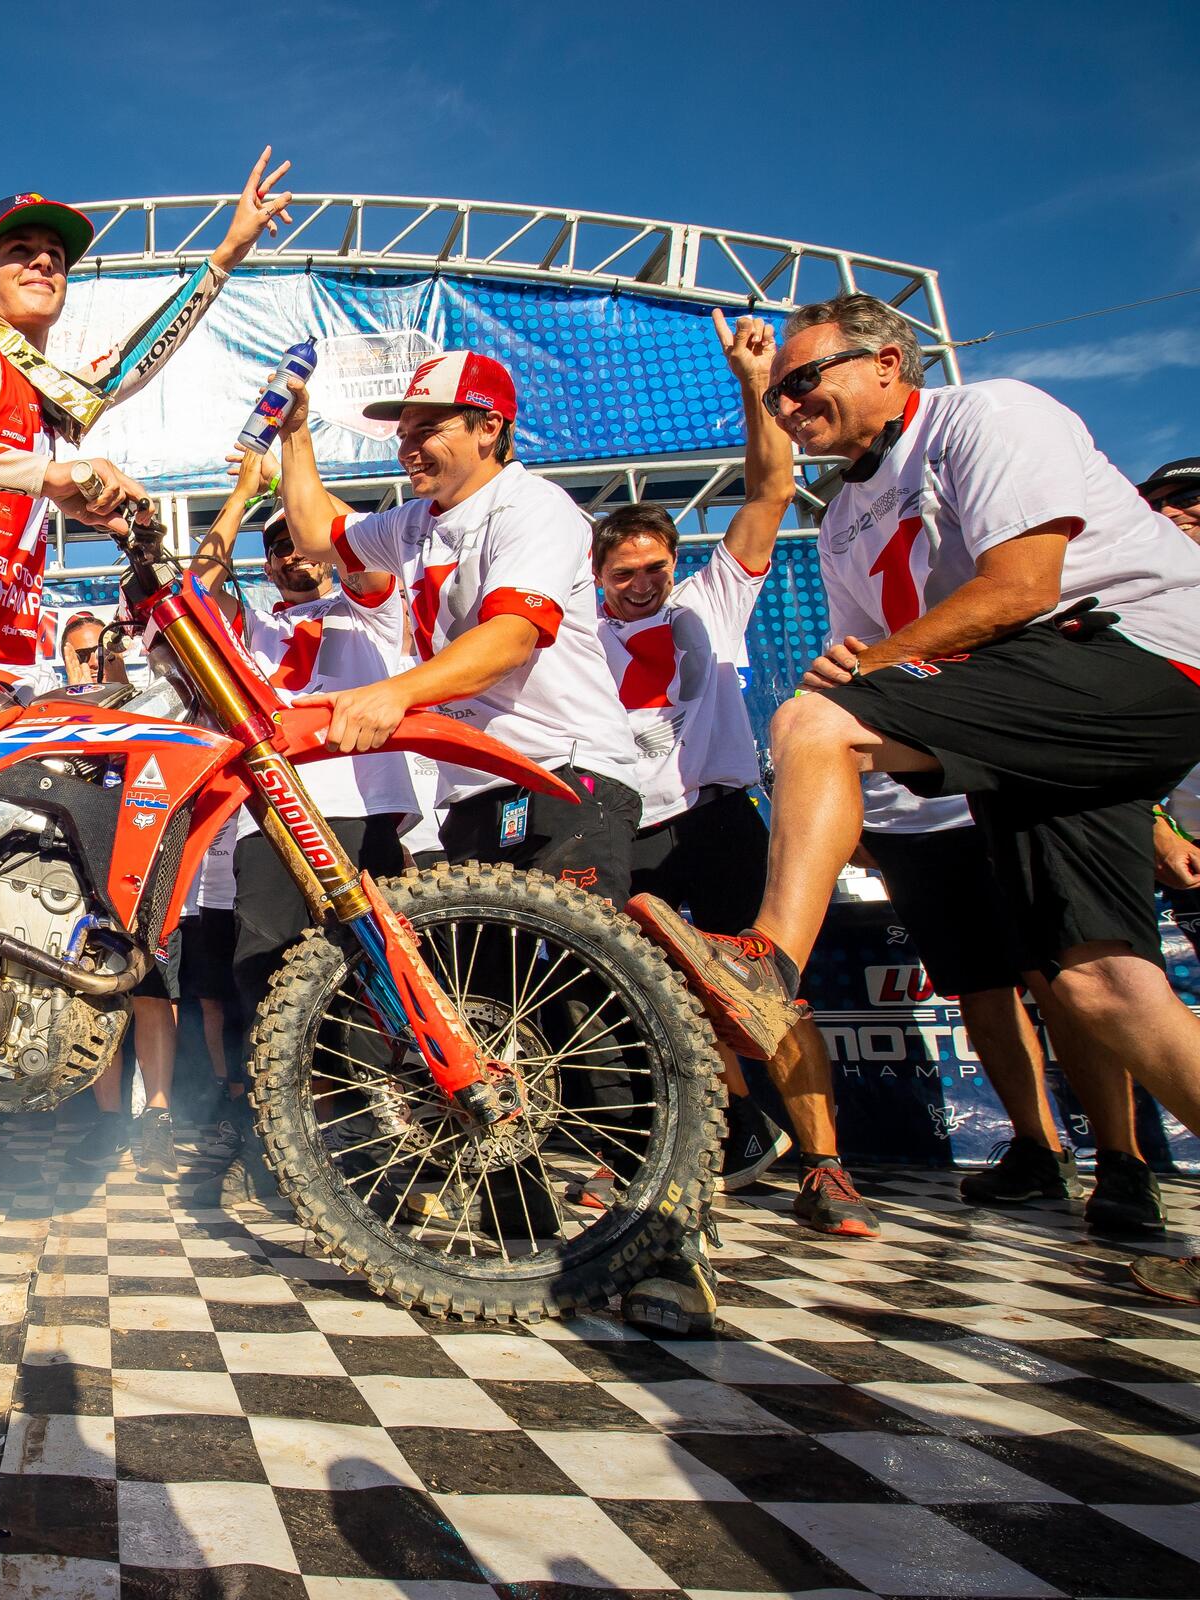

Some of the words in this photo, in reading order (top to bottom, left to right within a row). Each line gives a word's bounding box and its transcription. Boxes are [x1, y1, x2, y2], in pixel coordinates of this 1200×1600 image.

[135, 291, 205, 377] HONDA
[0, 429, 28, 445] SHOWA
[125, 791, 171, 811] HRC
[253, 767, 339, 870] SHOWA
[608, 1179, 684, 1273] DUNLOP
